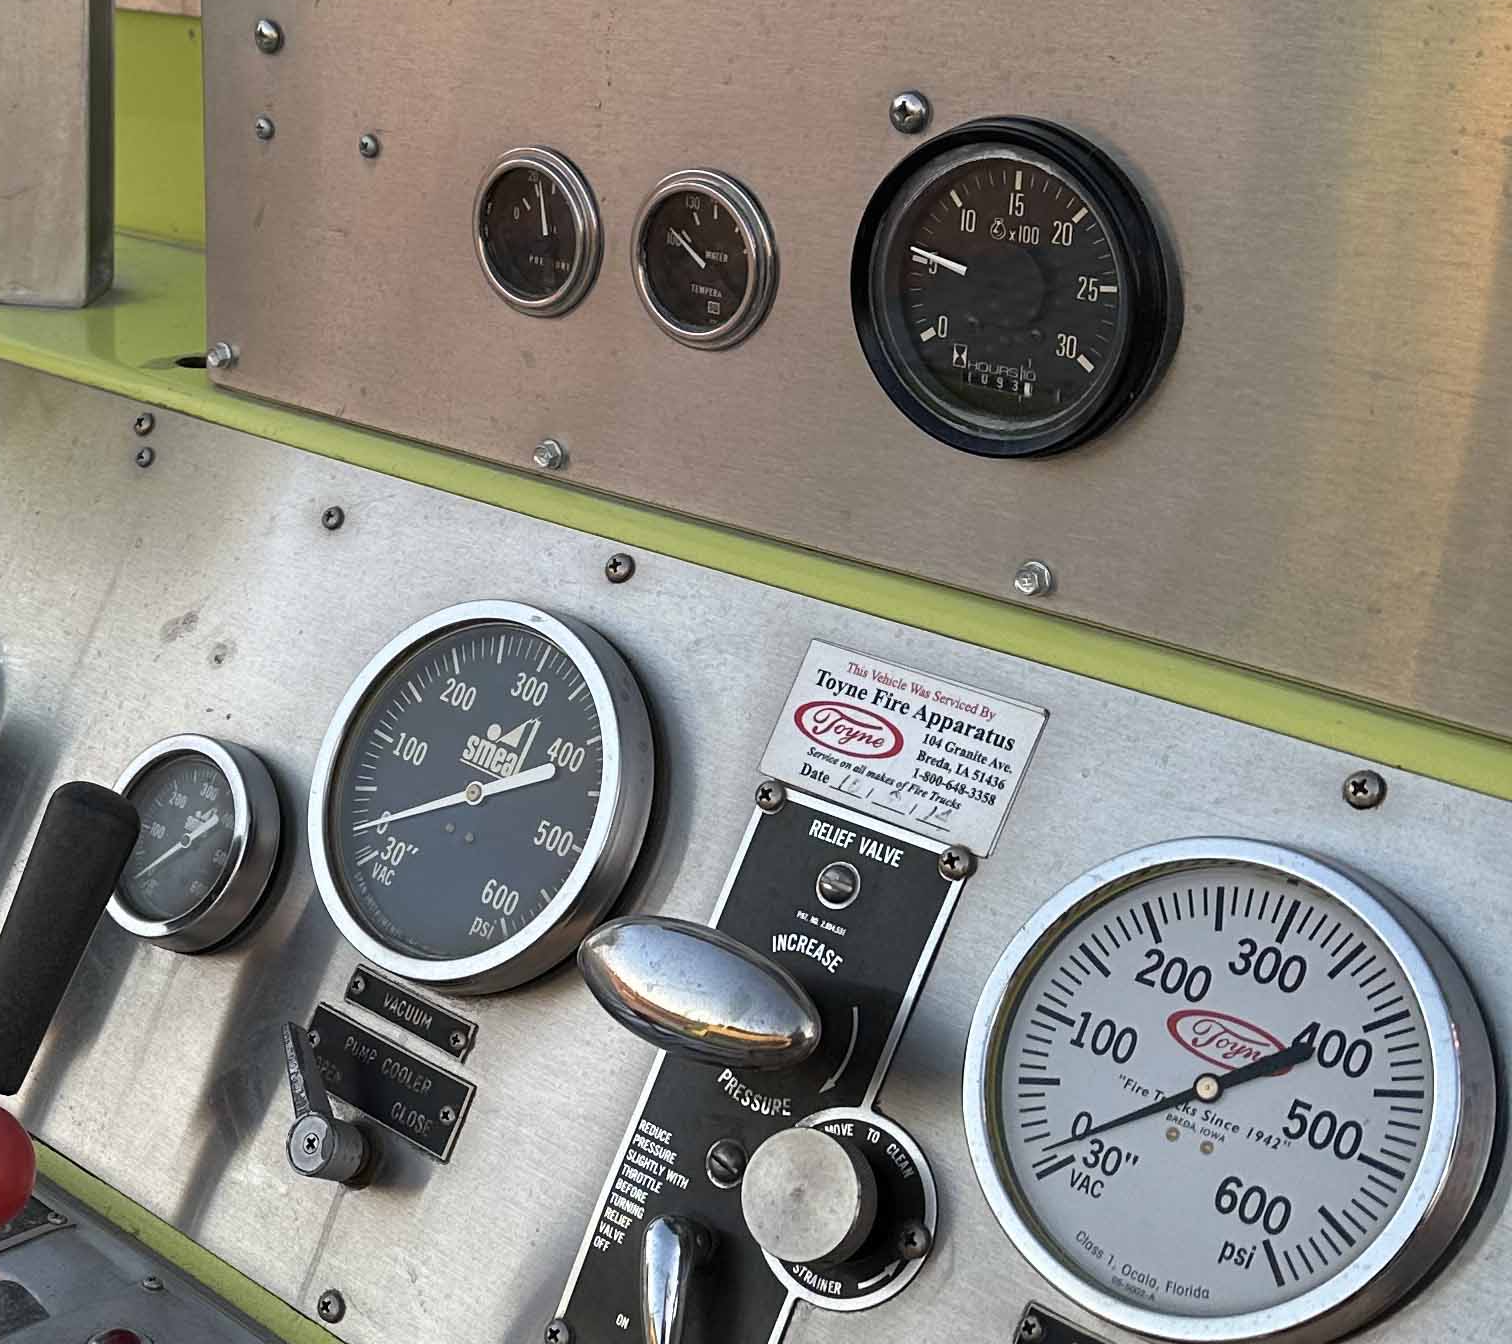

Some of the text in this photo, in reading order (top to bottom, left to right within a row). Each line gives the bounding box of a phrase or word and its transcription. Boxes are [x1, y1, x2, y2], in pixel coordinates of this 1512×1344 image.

[513, 206, 520, 220] 0
[960, 209, 976, 233] 10
[1008, 193, 1024, 217] 15
[1009, 225, 1040, 246] x100
[1052, 220, 1073, 247] 20
[705, 250, 729, 264] WATER
[928, 252, 938, 275] 5
[1077, 276, 1098, 302] 25
[938, 315, 948, 338] 0
[1056, 333, 1077, 359] 30
[968, 360, 1018, 378] HOURS
[440, 678, 477, 712] 200
[511, 672, 549, 706] 300
[848, 662, 997, 721] This Vehicle Was Serviced By
[816, 668, 1016, 751] Toyne Fire Apparatus
[813, 708, 885, 748] Toyne
[392, 732, 428, 766] 100
[547, 738, 585, 772] 400
[922, 733, 1012, 774] 104 Granite Ave.
[800, 762, 830, 784] Date
[807, 746, 839, 765] Service
[839, 760, 852, 770] on
[853, 764, 867, 775] all
[866, 770, 895, 786] makes
[896, 781, 909, 791] of
[907, 783, 929, 798] Fire
[929, 791, 962, 810] Trucks
[916, 749, 1006, 790] Breda, IA 51436
[169, 791, 187, 808] 200
[912, 768, 997, 806] 1-800-648-3358
[534, 820, 574, 857] 500
[809, 819, 904, 869] RELIEF VALVE
[372, 863, 396, 886] VAC
[481, 879, 519, 916] 600
[469, 916, 494, 940] psi
[772, 934, 844, 975] INCREASE
[1228, 938, 1306, 994] 300
[1135, 949, 1212, 1001] 200
[383, 992, 433, 1031] VACUUM
[1070, 1012, 1138, 1064] 100
[1192, 1018, 1271, 1061] Toyn
[1293, 1020, 1374, 1078] 400
[345, 1035, 432, 1095] PUMP COOLER
[717, 1068, 791, 1118] PRESSURE
[391, 1102, 433, 1137] CLOSE
[1071, 1111, 1093, 1142] 0
[1119, 1074, 1291, 1151] "Fire Since 1942"
[1281, 1098, 1363, 1160] 500
[638, 1119, 672, 1145] REDUCE
[1199, 1127, 1226, 1143] IOWA
[632, 1134, 678, 1165] PRESSURE
[867, 1128, 880, 1143] TO
[886, 1143, 915, 1179] CLEAN
[1081, 1138, 1139, 1178] 30"
[621, 1163, 663, 1194] THROTTLE
[626, 1149, 690, 1190] SLIGHTLY WITH
[1068, 1170, 1105, 1199] VAC
[609, 1192, 645, 1220] TURNING
[615, 1178, 648, 1204] BEFORE
[1215, 1175, 1292, 1235] 600
[598, 1220, 626, 1245] VALVE
[604, 1206, 633, 1229] RELIEF
[593, 1235, 611, 1252] OFF
[1218, 1240, 1256, 1270] psi
[792, 1263, 842, 1295] STRAINER
[1076, 1230, 1104, 1259] Class
[1165, 1280, 1210, 1299] Florida
[615, 1313, 630, 1329] ON
